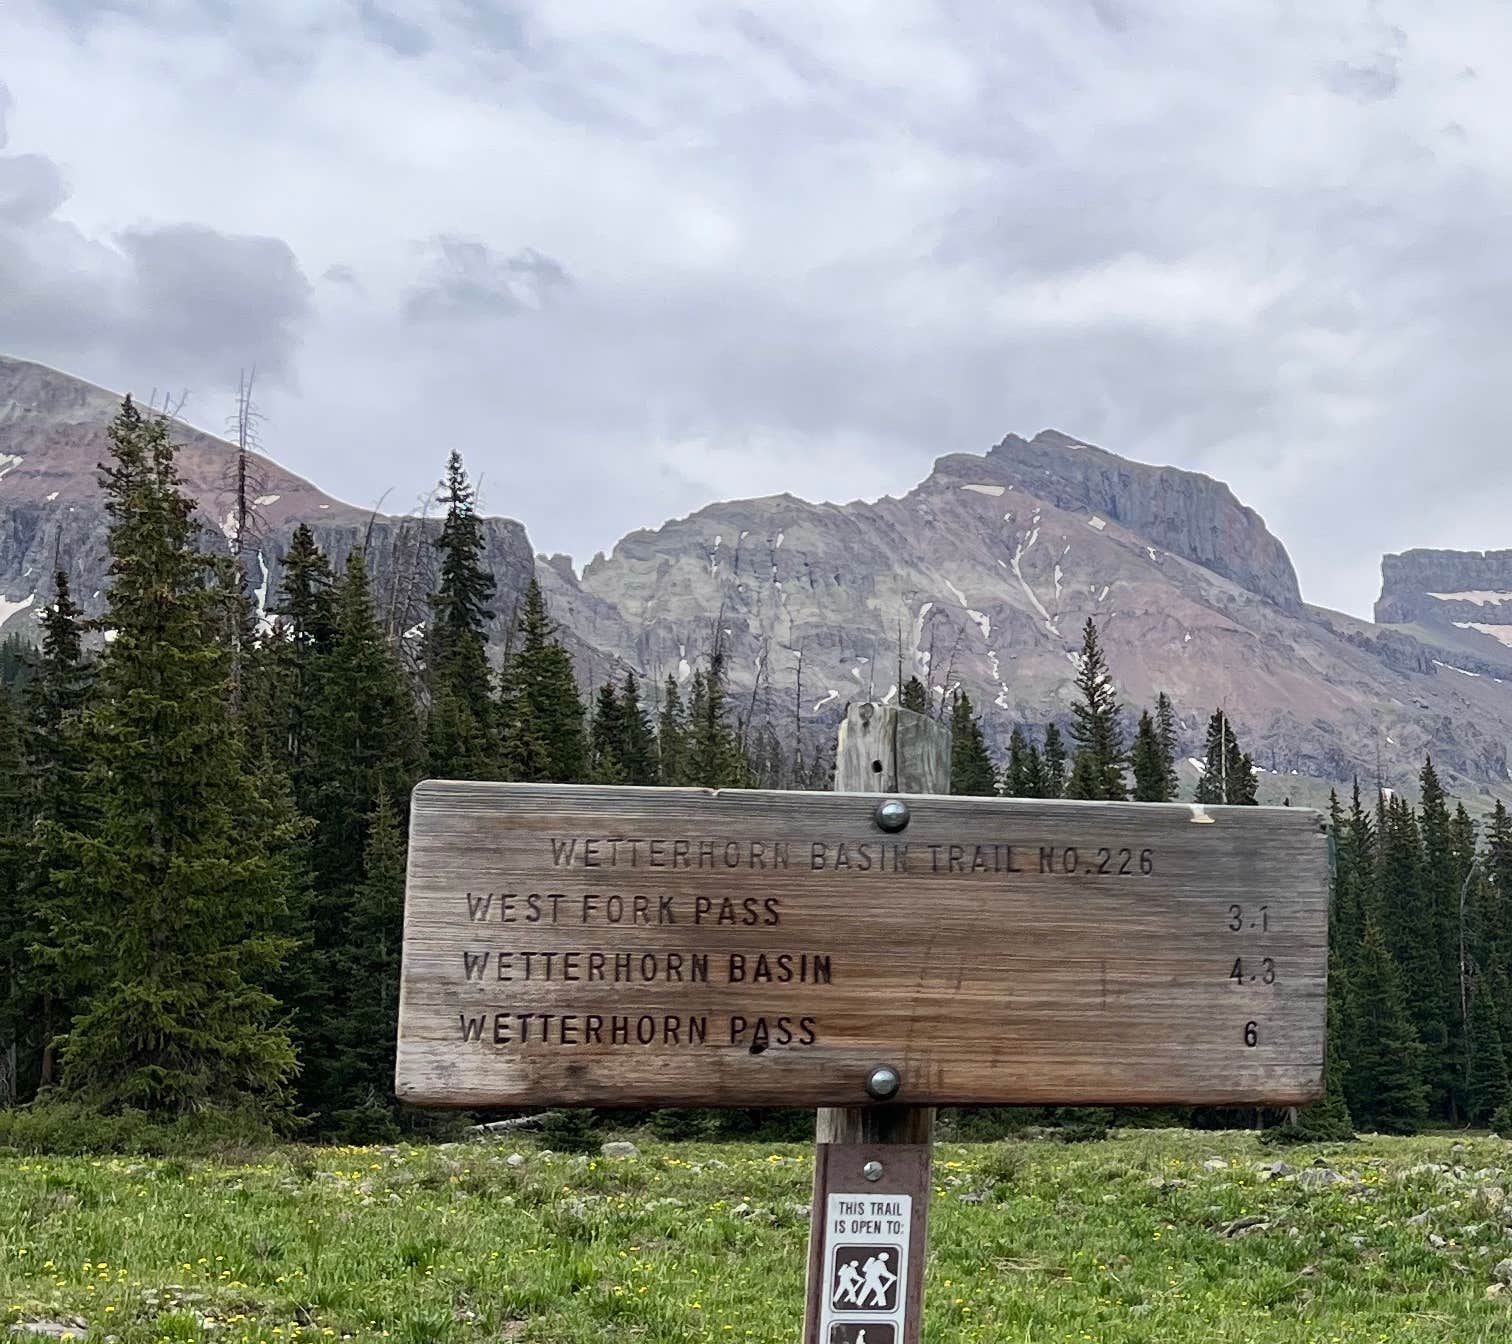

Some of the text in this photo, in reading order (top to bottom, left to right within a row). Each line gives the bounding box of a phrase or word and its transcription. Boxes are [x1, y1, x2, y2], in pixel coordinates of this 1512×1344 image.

[551, 838, 789, 870] WETTERHORN
[811, 841, 908, 872] BASIN
[927, 843, 1021, 873] TRAIL
[466, 893, 780, 925] WEST FORK PASS
[1229, 905, 1268, 932] 3.1
[464, 952, 832, 984] WETTERHORN BASIN
[1229, 957, 1275, 985] 4.3
[460, 1012, 816, 1045] WETTERHORN PASS
[1244, 1020, 1258, 1047] 6
[839, 1202, 902, 1216] THIS TRAIL
[834, 1220, 905, 1235] IS OPEN TO:
